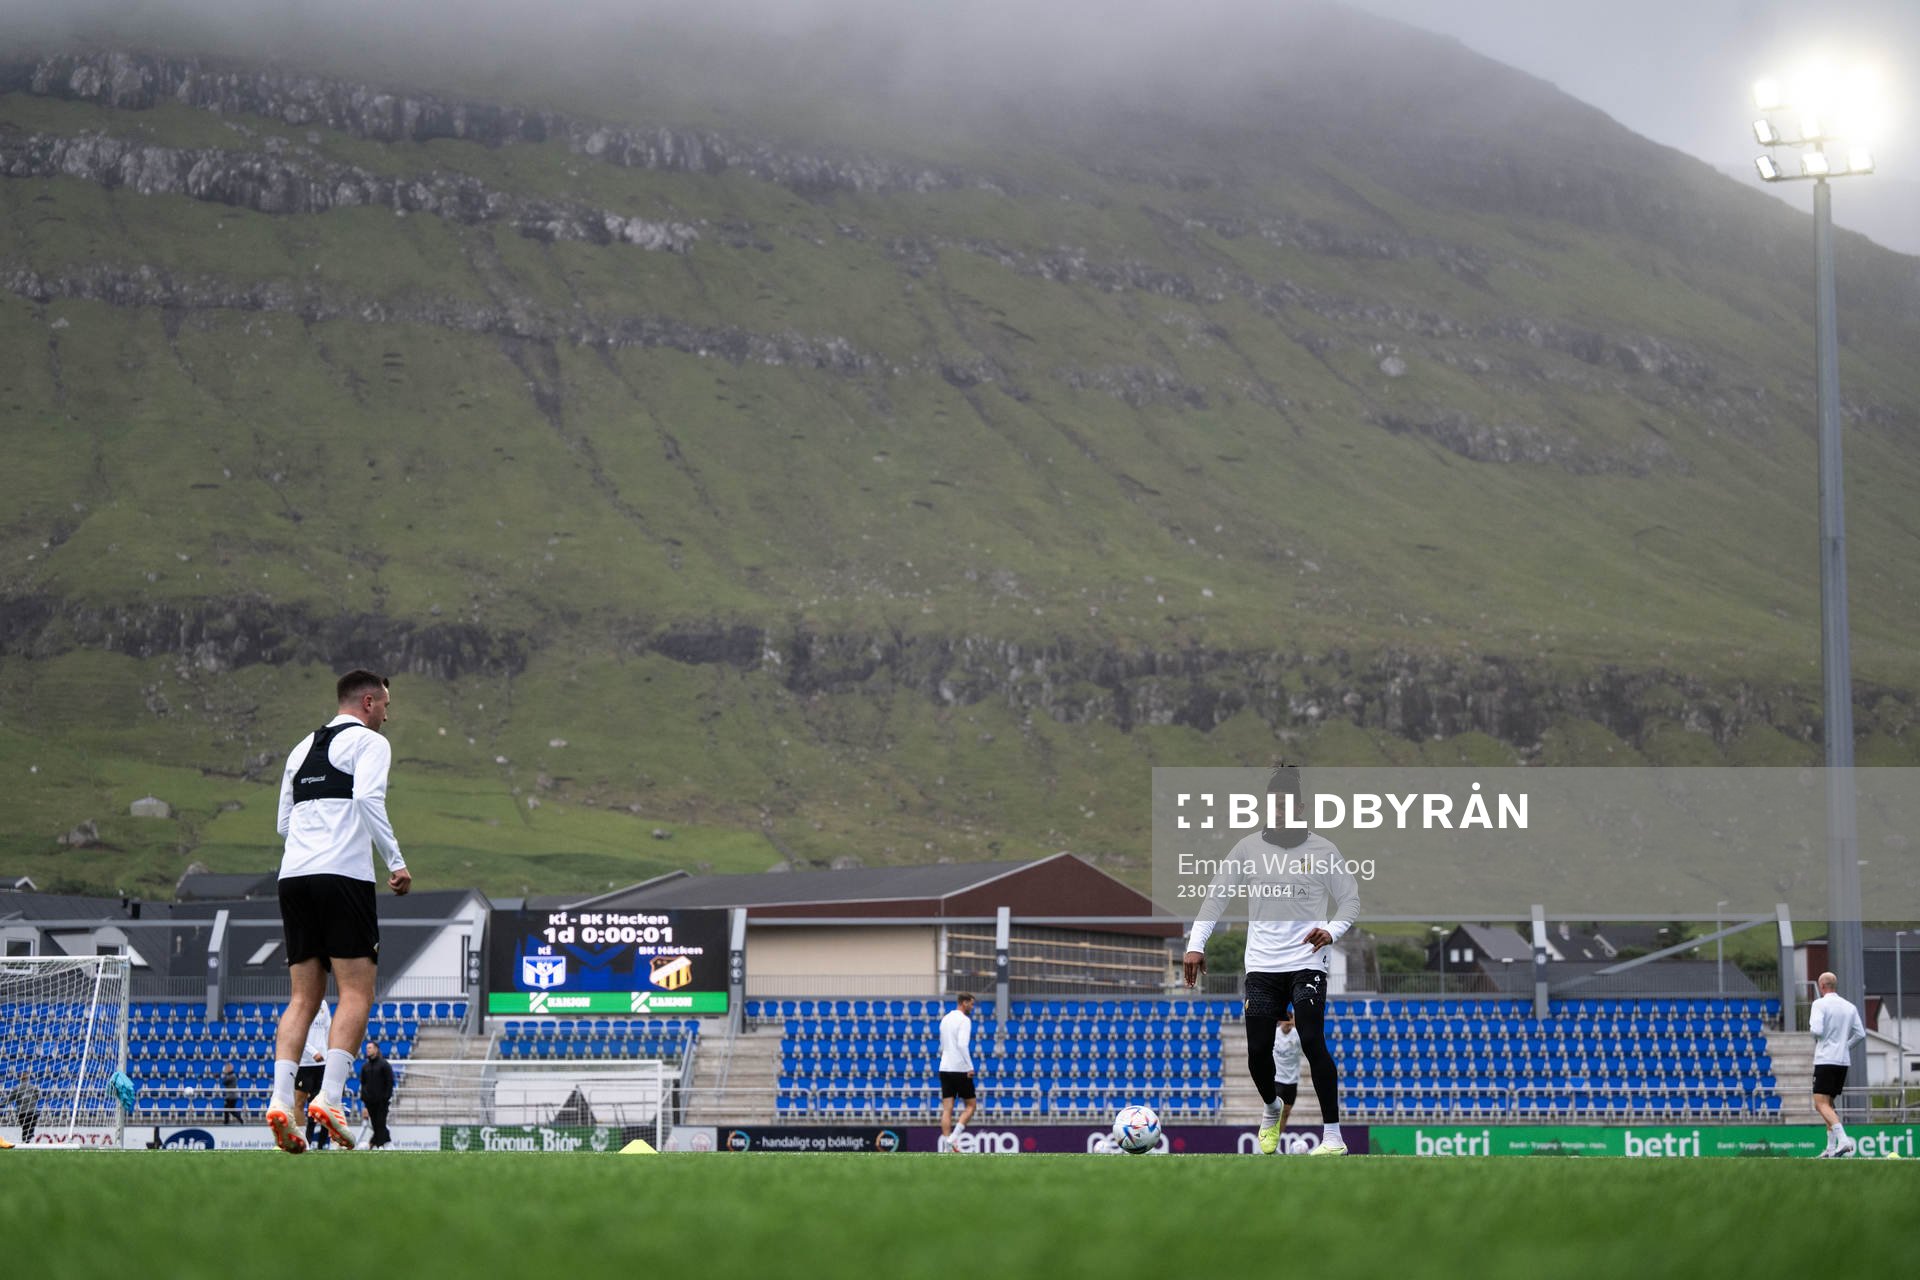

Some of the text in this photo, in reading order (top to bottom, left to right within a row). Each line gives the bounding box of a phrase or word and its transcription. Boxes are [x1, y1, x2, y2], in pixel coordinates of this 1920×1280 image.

[580, 914, 603, 925] BK
[543, 927, 673, 943] 1d 0:00:01
[638, 946, 656, 955] BK
[34, 1132, 114, 1145] OYOTA
[762, 1136, 811, 1149] handaligt
[812, 1139, 826, 1149] og
[1415, 1130, 1490, 1156] betri
[1624, 1130, 1700, 1157] betri
